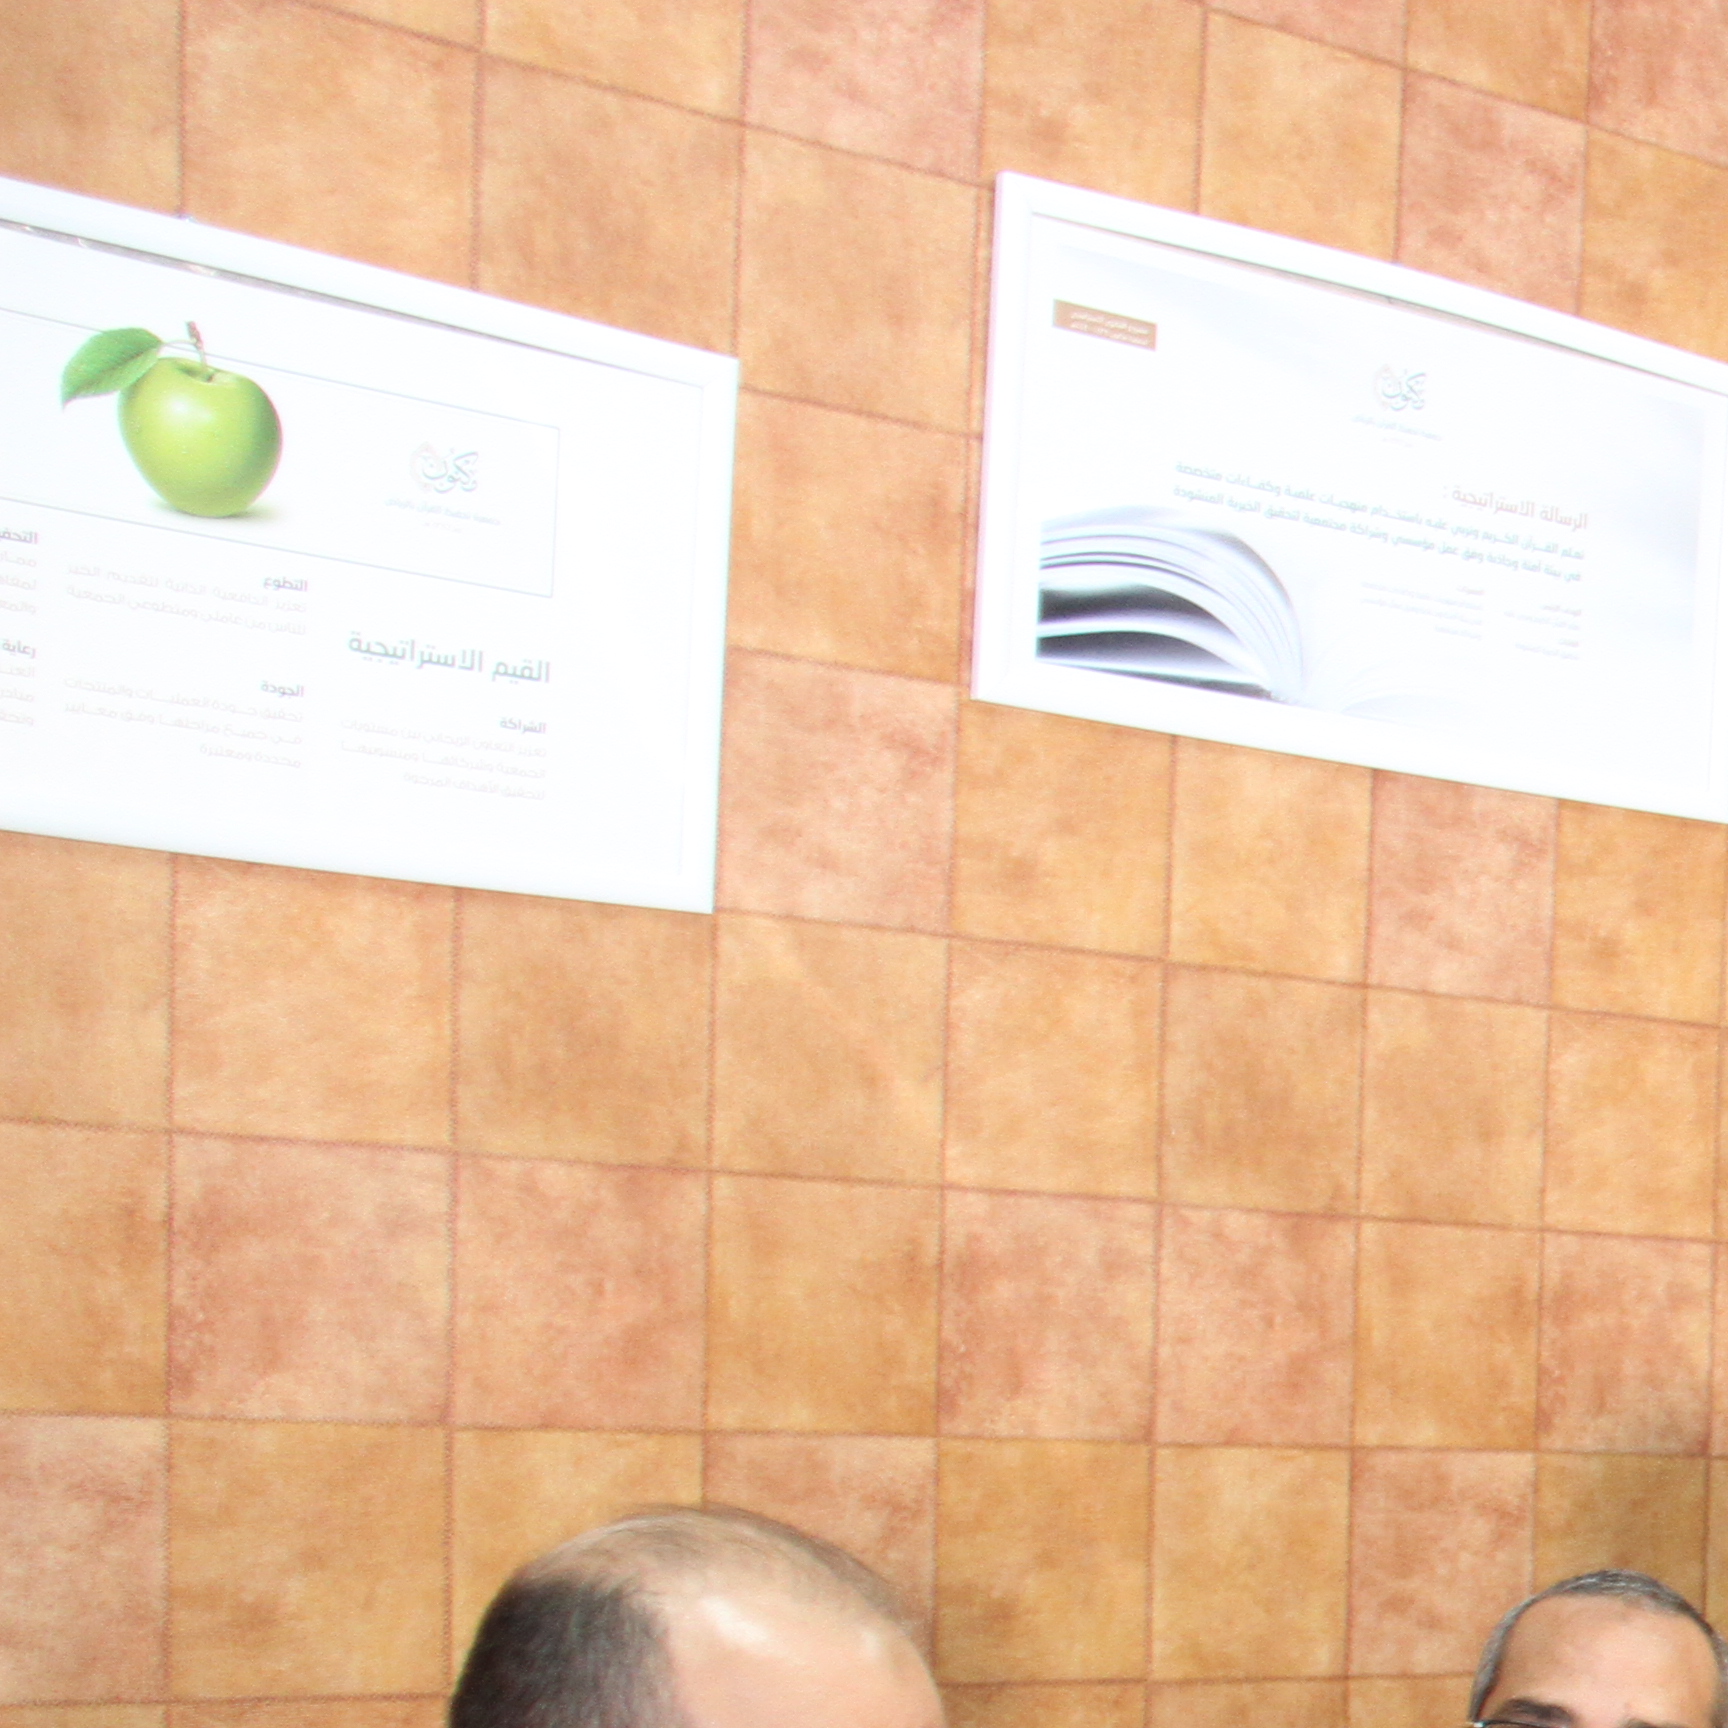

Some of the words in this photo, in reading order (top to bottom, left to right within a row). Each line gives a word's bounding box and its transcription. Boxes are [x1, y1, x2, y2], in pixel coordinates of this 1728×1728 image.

[1451, 484, 1535, 518] الاستراتيجية
[1539, 505, 1588, 532] الرسالة
[260, 575, 309, 592] التطوع
[346, 630, 484, 673] الاستراتيجية
[490, 658, 551, 684] القيم
[259, 679, 305, 698] الجودة
[498, 715, 547, 734] الشراكة
